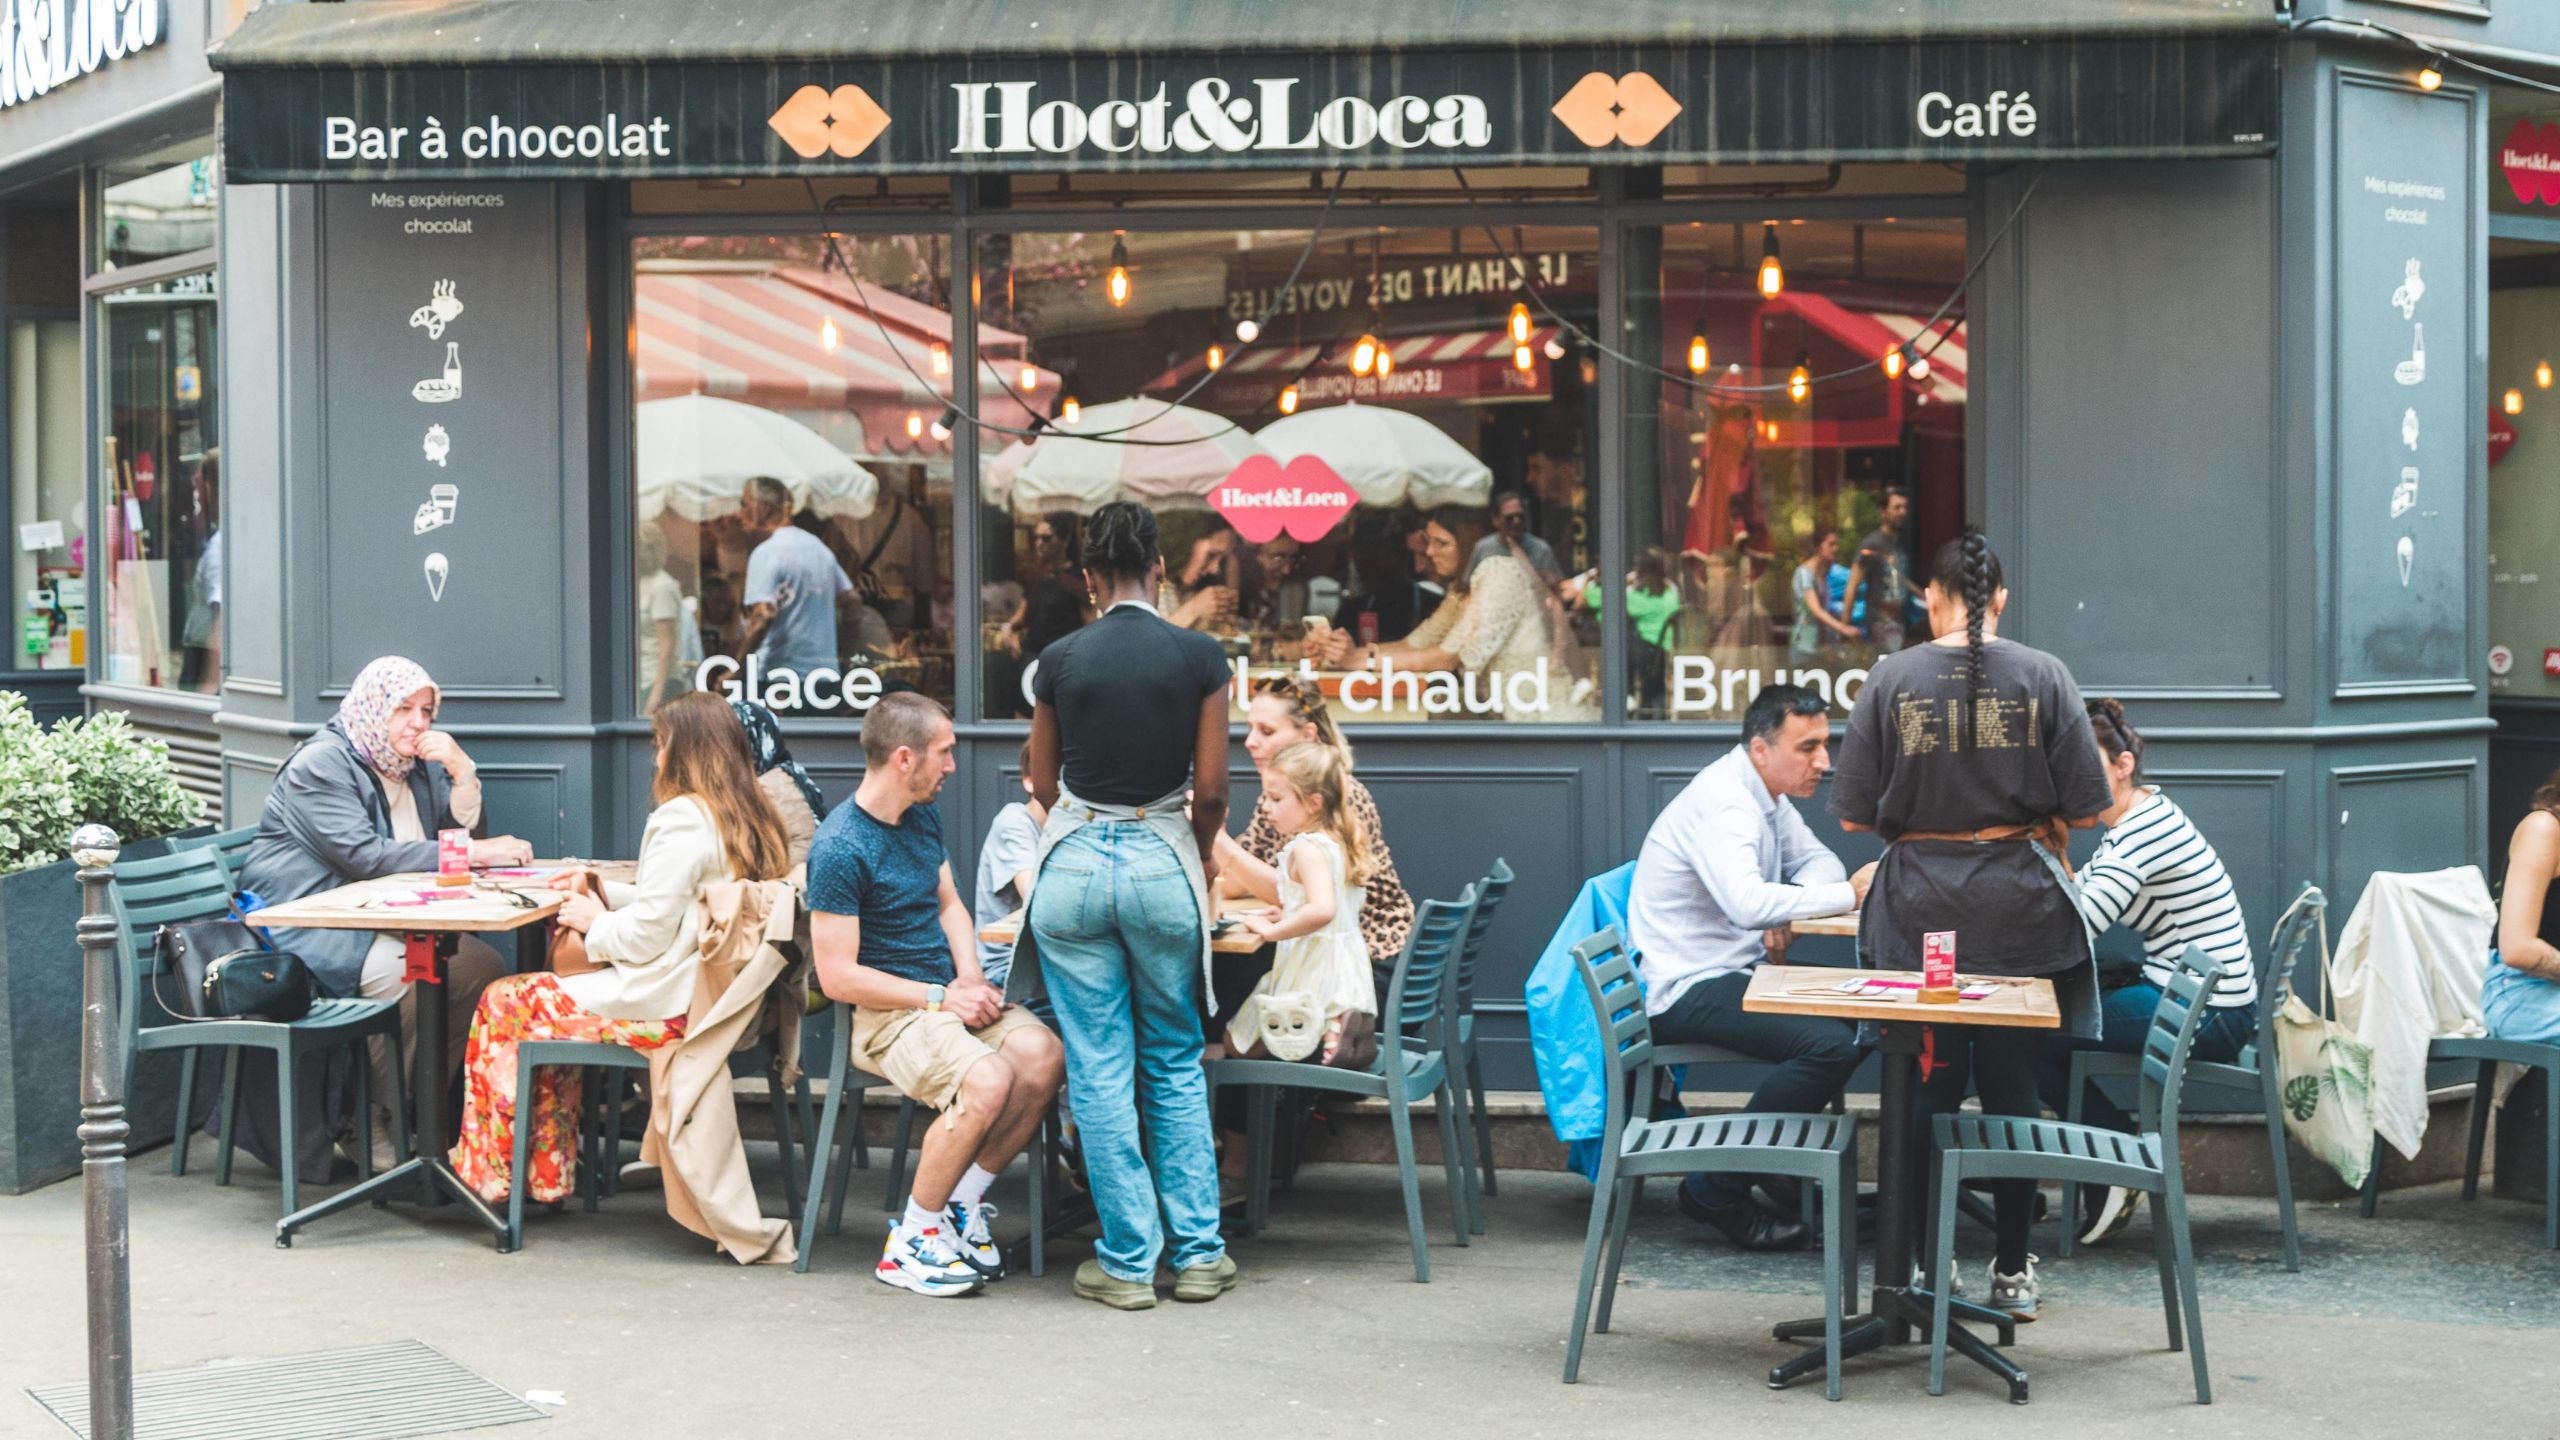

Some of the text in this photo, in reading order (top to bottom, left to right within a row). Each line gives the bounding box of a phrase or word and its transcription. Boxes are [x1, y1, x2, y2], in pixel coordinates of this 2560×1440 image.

[0, 0, 157, 108] t&Loca
[327, 114, 670, 159] Bar à chocolat
[951, 78, 1491, 153] Hoct&Loca
[1917, 91, 2036, 137] Café
[371, 192, 504, 211] Mes expériences
[404, 217, 473, 234] chocolat
[1221, 487, 1347, 508] Hoct&Loca
[1339, 655, 1551, 714] chaud
